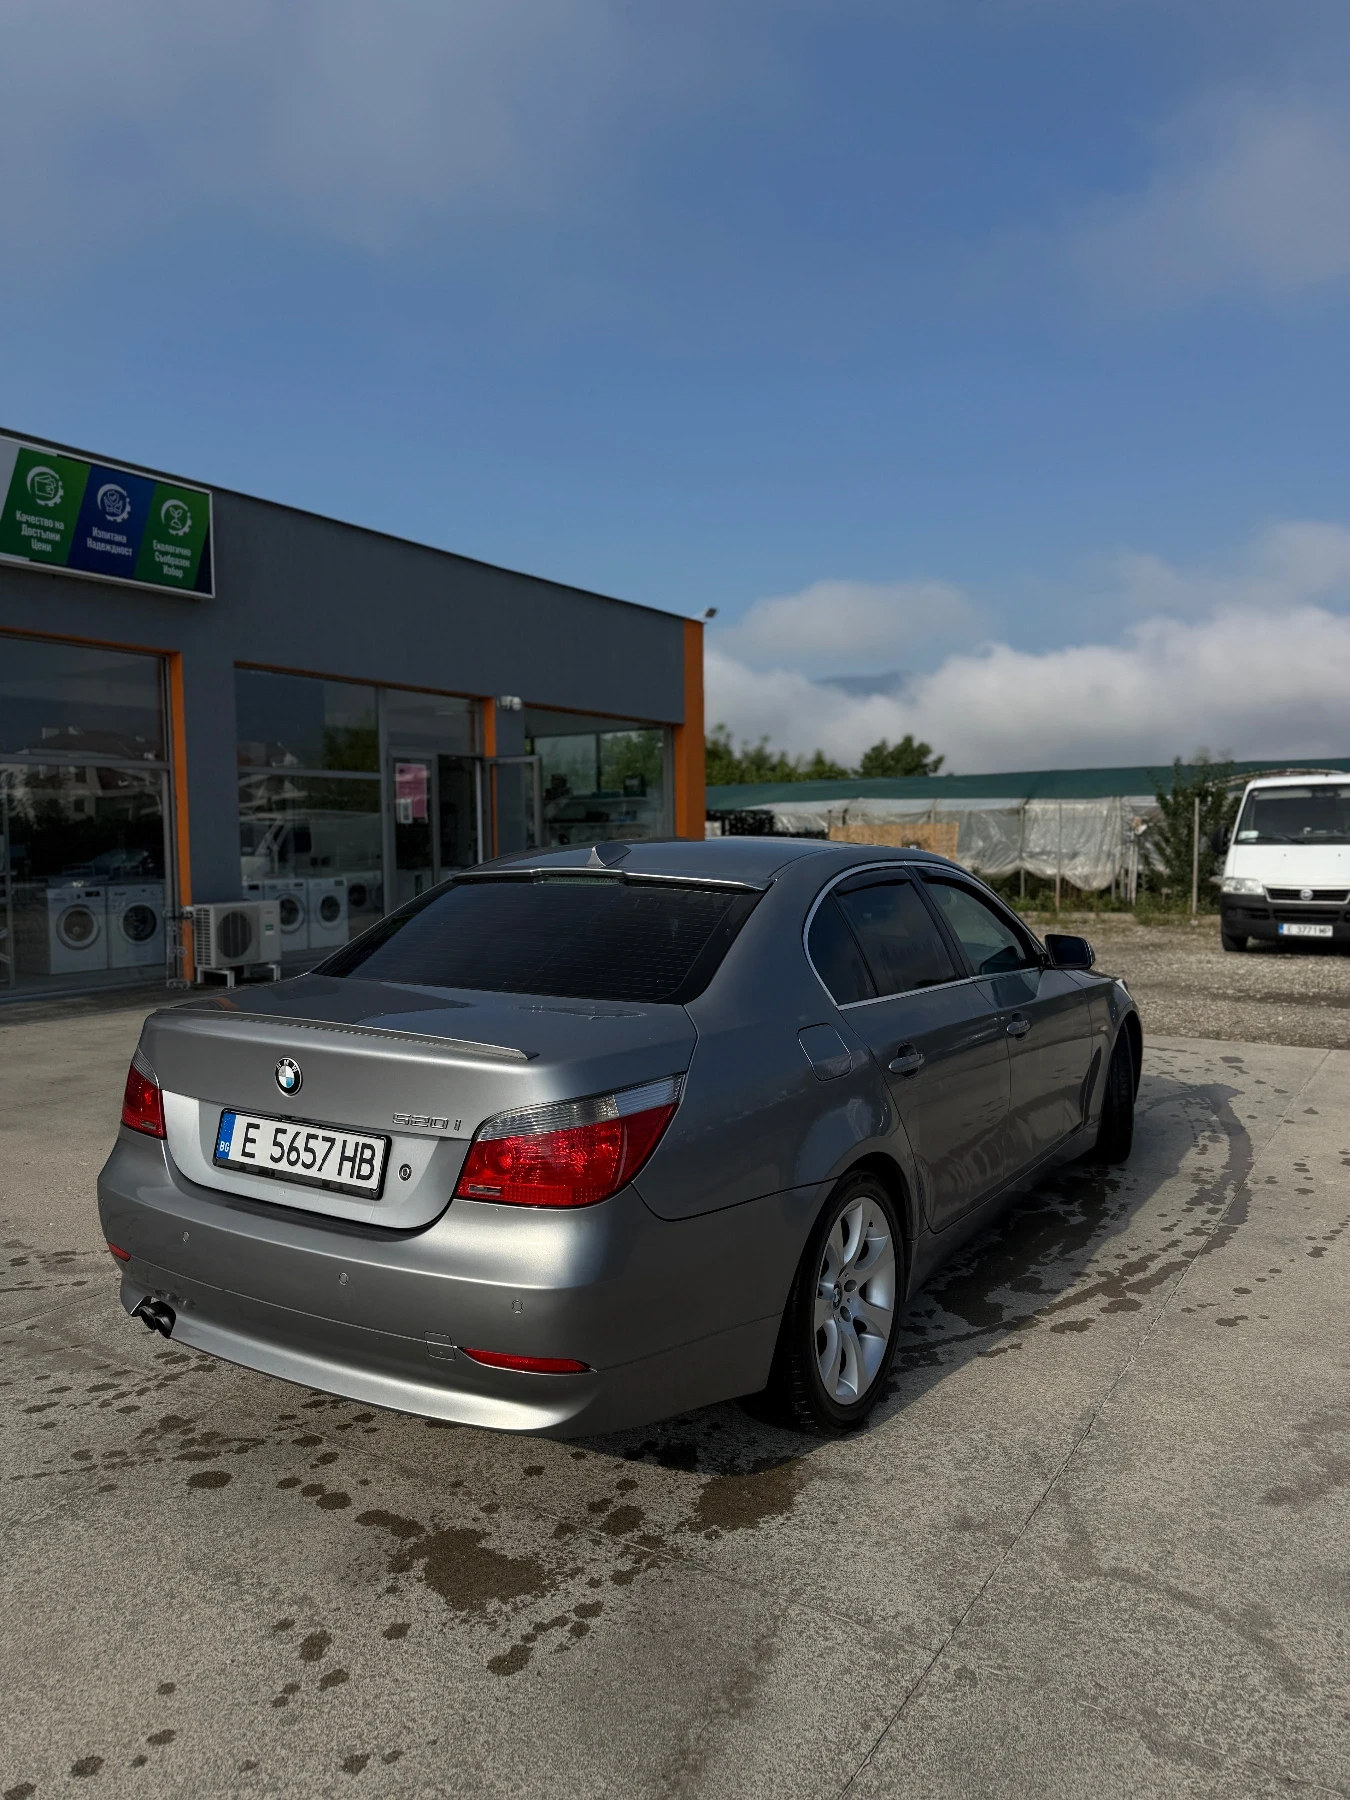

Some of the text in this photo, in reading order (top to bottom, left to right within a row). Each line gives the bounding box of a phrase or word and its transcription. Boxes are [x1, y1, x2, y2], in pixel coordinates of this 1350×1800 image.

[16, 510, 65, 530] Качество на
[21, 523, 61, 542] Достъпни
[92, 526, 127, 544] Изпитана
[31, 538, 52, 552] Цени
[86, 537, 133, 556] Надеждност
[152, 539, 192, 557] Екологично
[154, 551, 191, 567] Съобразен
[162, 564, 184, 579] Избор
[219, 1141, 230, 1152] BG
[241, 1122, 376, 1181] E 5657 HB
